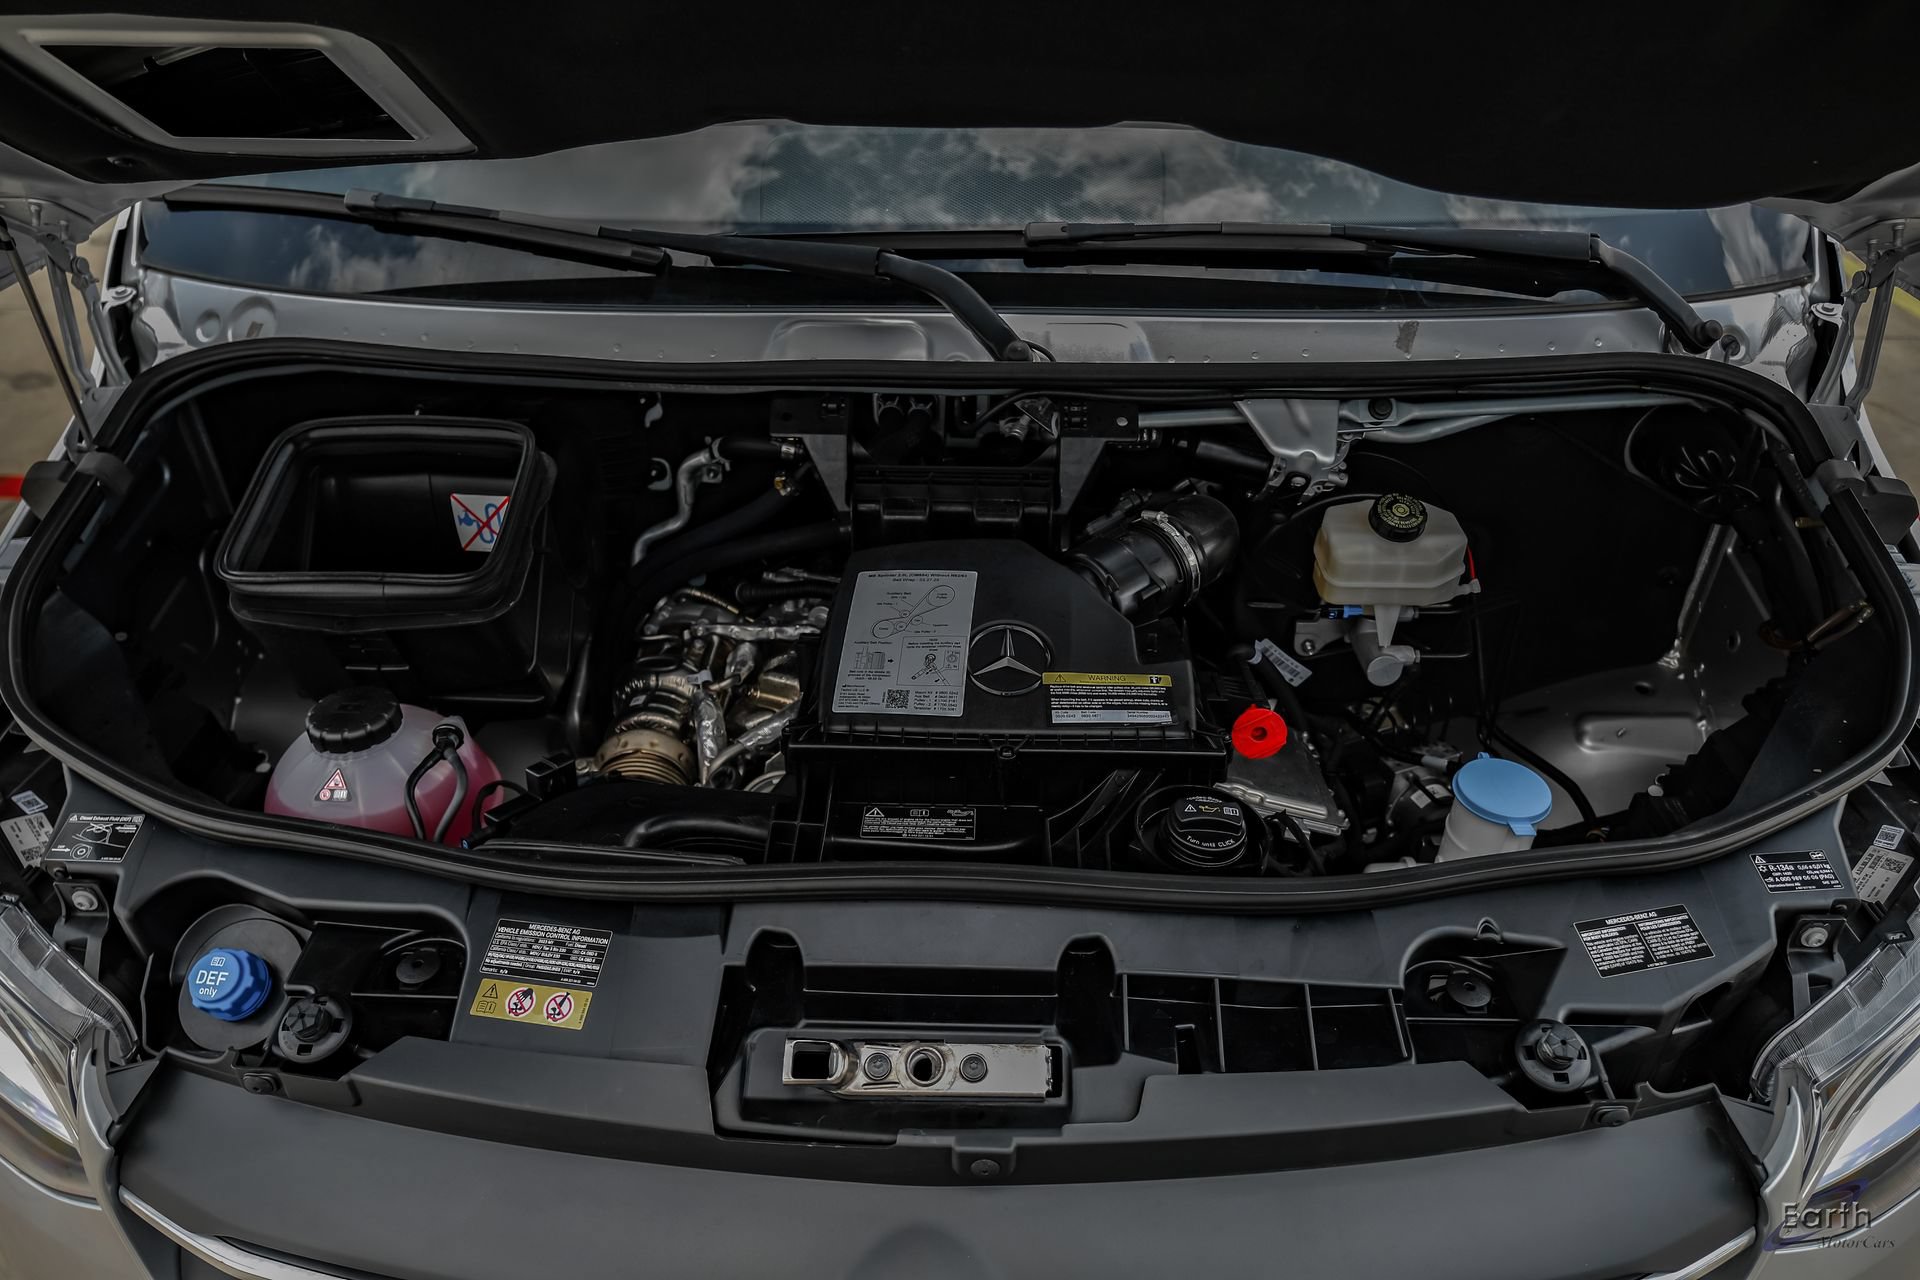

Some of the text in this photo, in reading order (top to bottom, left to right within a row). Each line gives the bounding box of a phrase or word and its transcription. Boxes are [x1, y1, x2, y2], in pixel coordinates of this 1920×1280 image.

[1186, 836, 1200, 845] Turn
[1218, 839, 1236, 847] CLICK
[1605, 913, 1649, 925] MERCEDES-BENZ
[528, 924, 572, 934] MERCEDES-BENZ
[497, 926, 608, 945] VEHICLE EMISSION CONTROL INFORMATION
[196, 970, 229, 986] DEF
[199, 987, 218, 998] only
